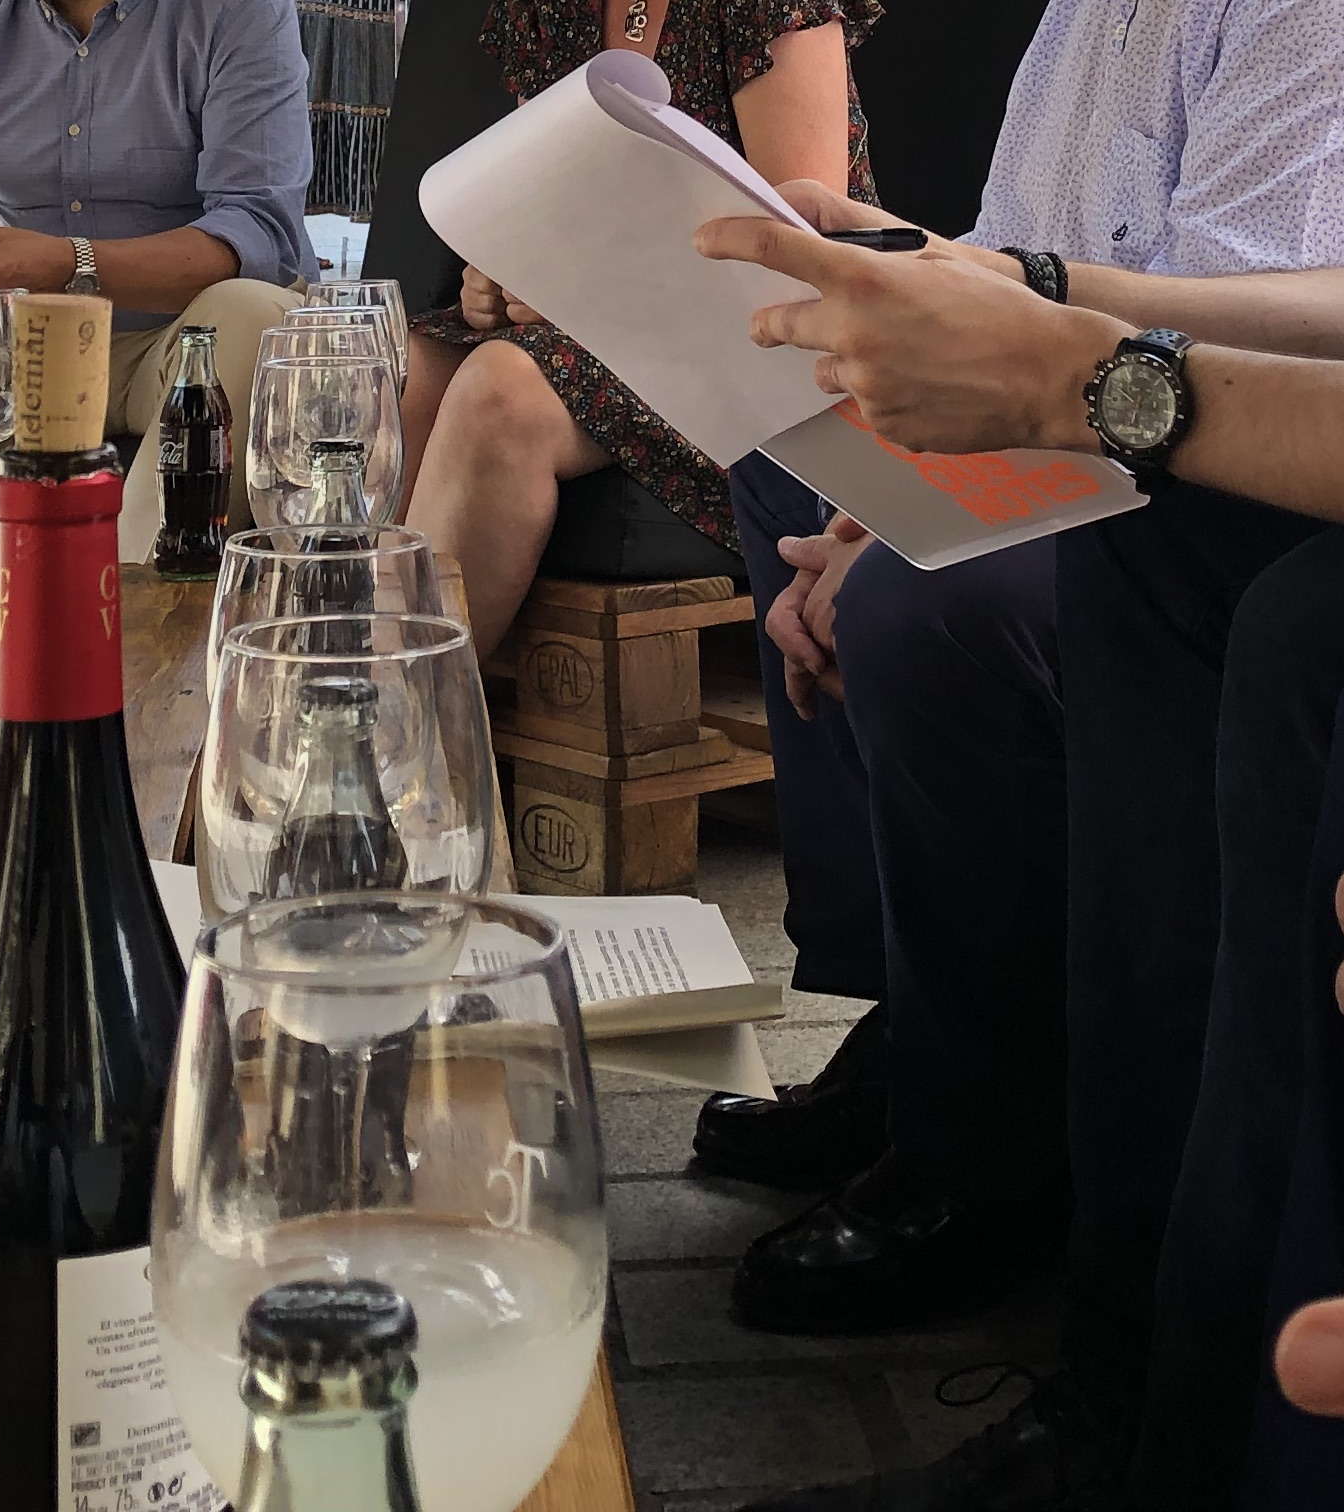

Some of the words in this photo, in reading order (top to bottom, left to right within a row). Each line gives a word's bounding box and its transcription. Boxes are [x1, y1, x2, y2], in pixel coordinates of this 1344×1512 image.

[956, 461, 1102, 527] NOTES
[536, 651, 584, 700] EPAL
[533, 812, 576, 856] EUR
